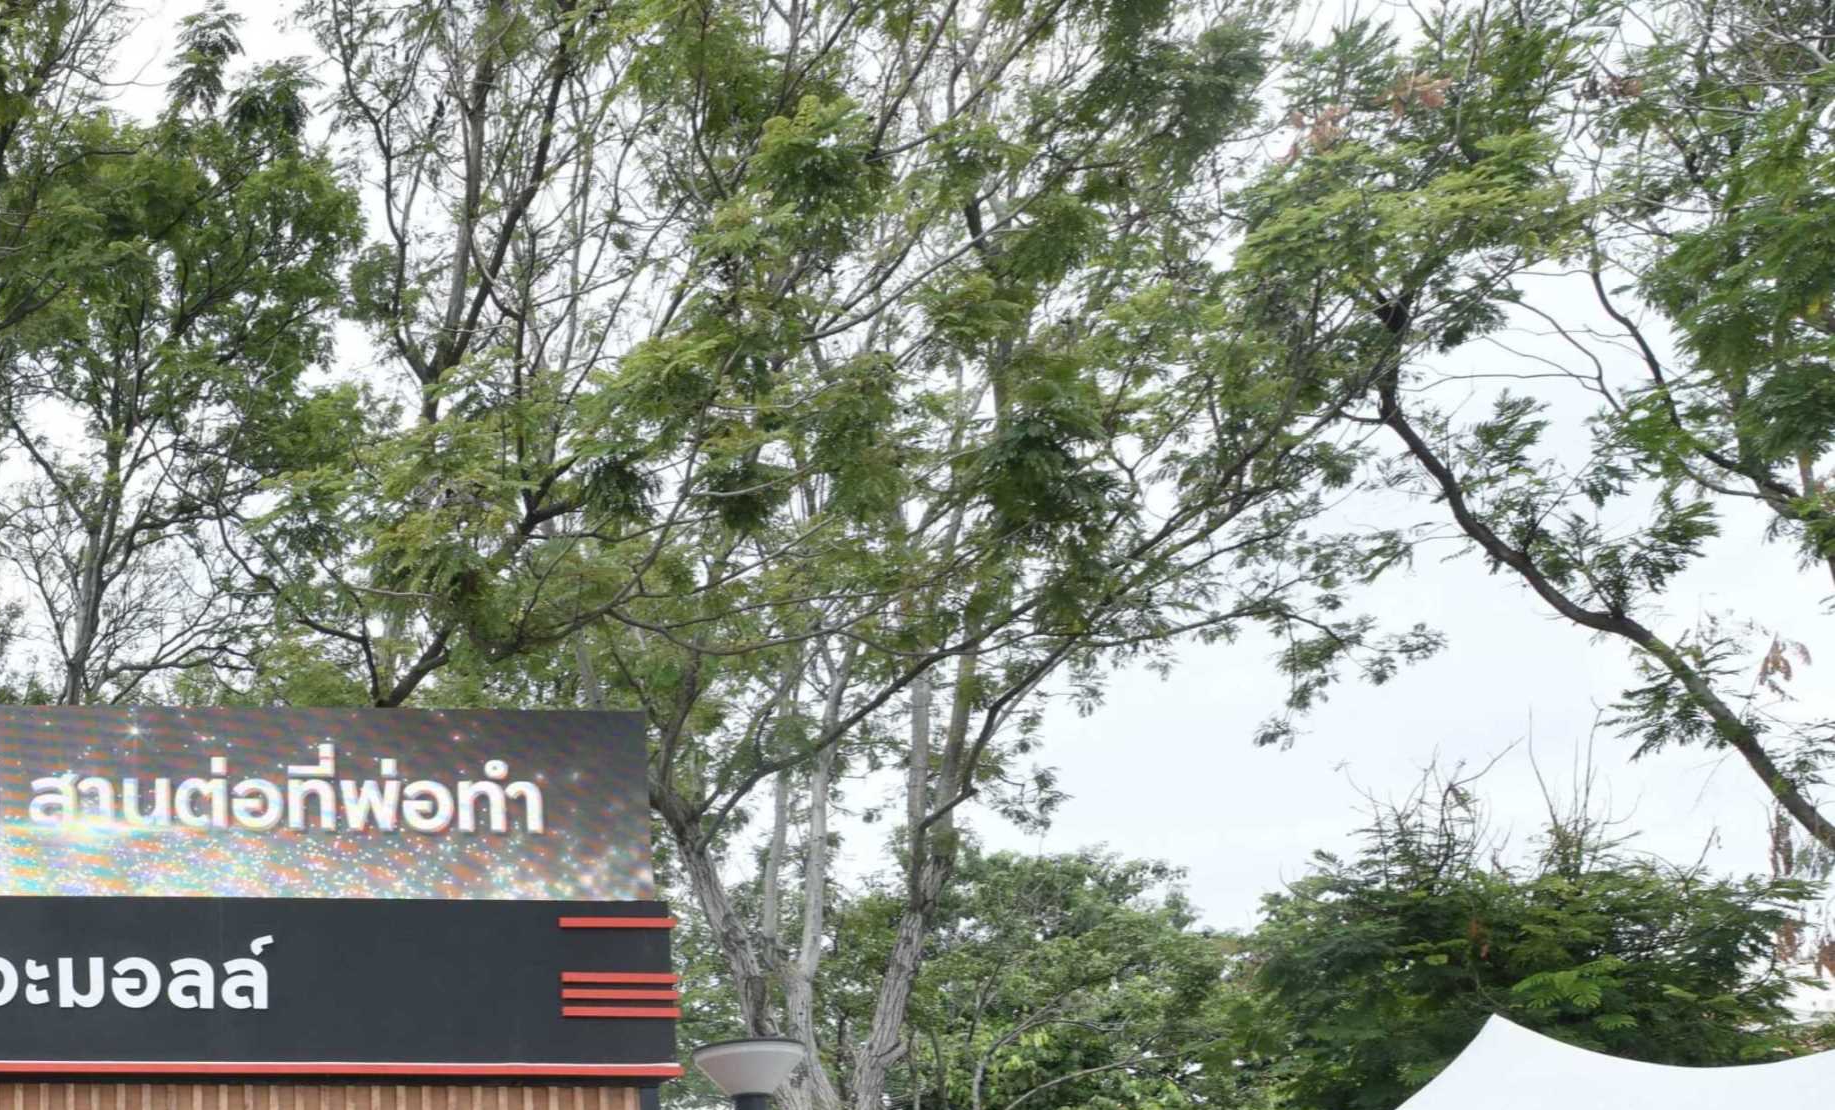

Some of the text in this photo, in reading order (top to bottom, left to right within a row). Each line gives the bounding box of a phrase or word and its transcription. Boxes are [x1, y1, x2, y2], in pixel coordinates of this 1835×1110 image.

[27, 742, 545, 834] สานต่อที่พ่อทำ
